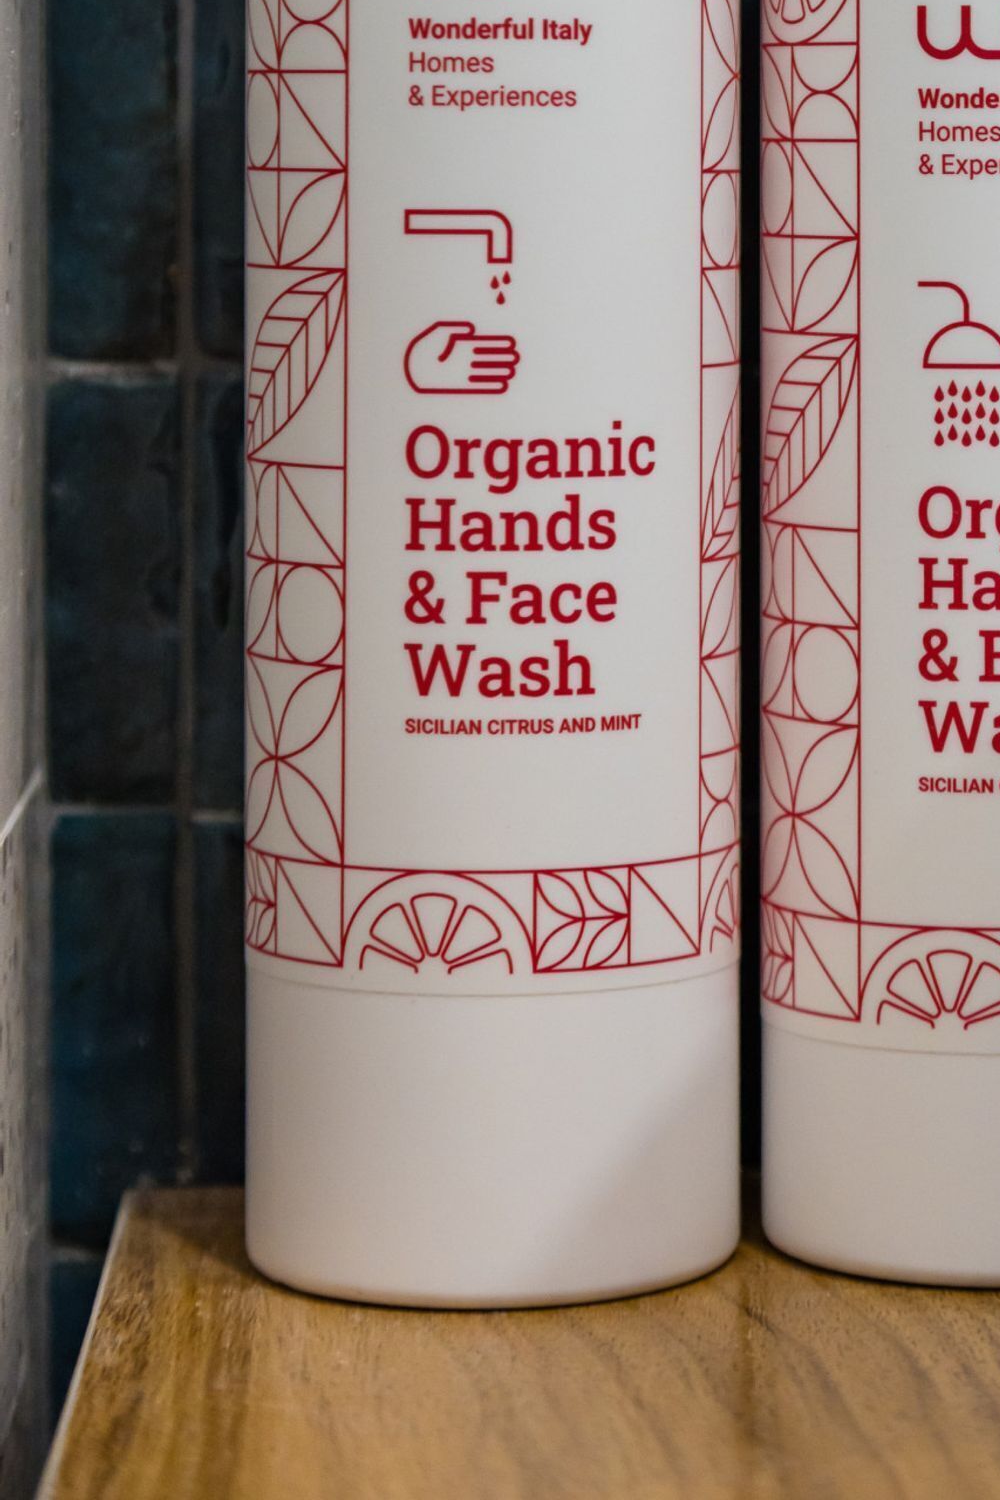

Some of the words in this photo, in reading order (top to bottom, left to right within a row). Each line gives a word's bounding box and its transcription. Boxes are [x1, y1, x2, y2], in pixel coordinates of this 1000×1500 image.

[408, 17, 534, 40] Wonderful
[542, 18, 593, 46] Italy
[409, 52, 495, 73] Homes
[408, 85, 424, 106] &
[431, 85, 577, 111] Experiences
[918, 154, 934, 175] &
[404, 420, 656, 495] Organic
[404, 494, 617, 552] Hands
[403, 570, 446, 625] &
[465, 570, 618, 626] Face
[403, 638, 596, 699] Wash
[917, 628, 959, 683] &
[404, 718, 482, 736] SICILIAN
[487, 719, 554, 736] CITRUS
[558, 717, 597, 734] AND
[600, 713, 642, 732] MINT
[918, 776, 994, 794] SICILIAN
